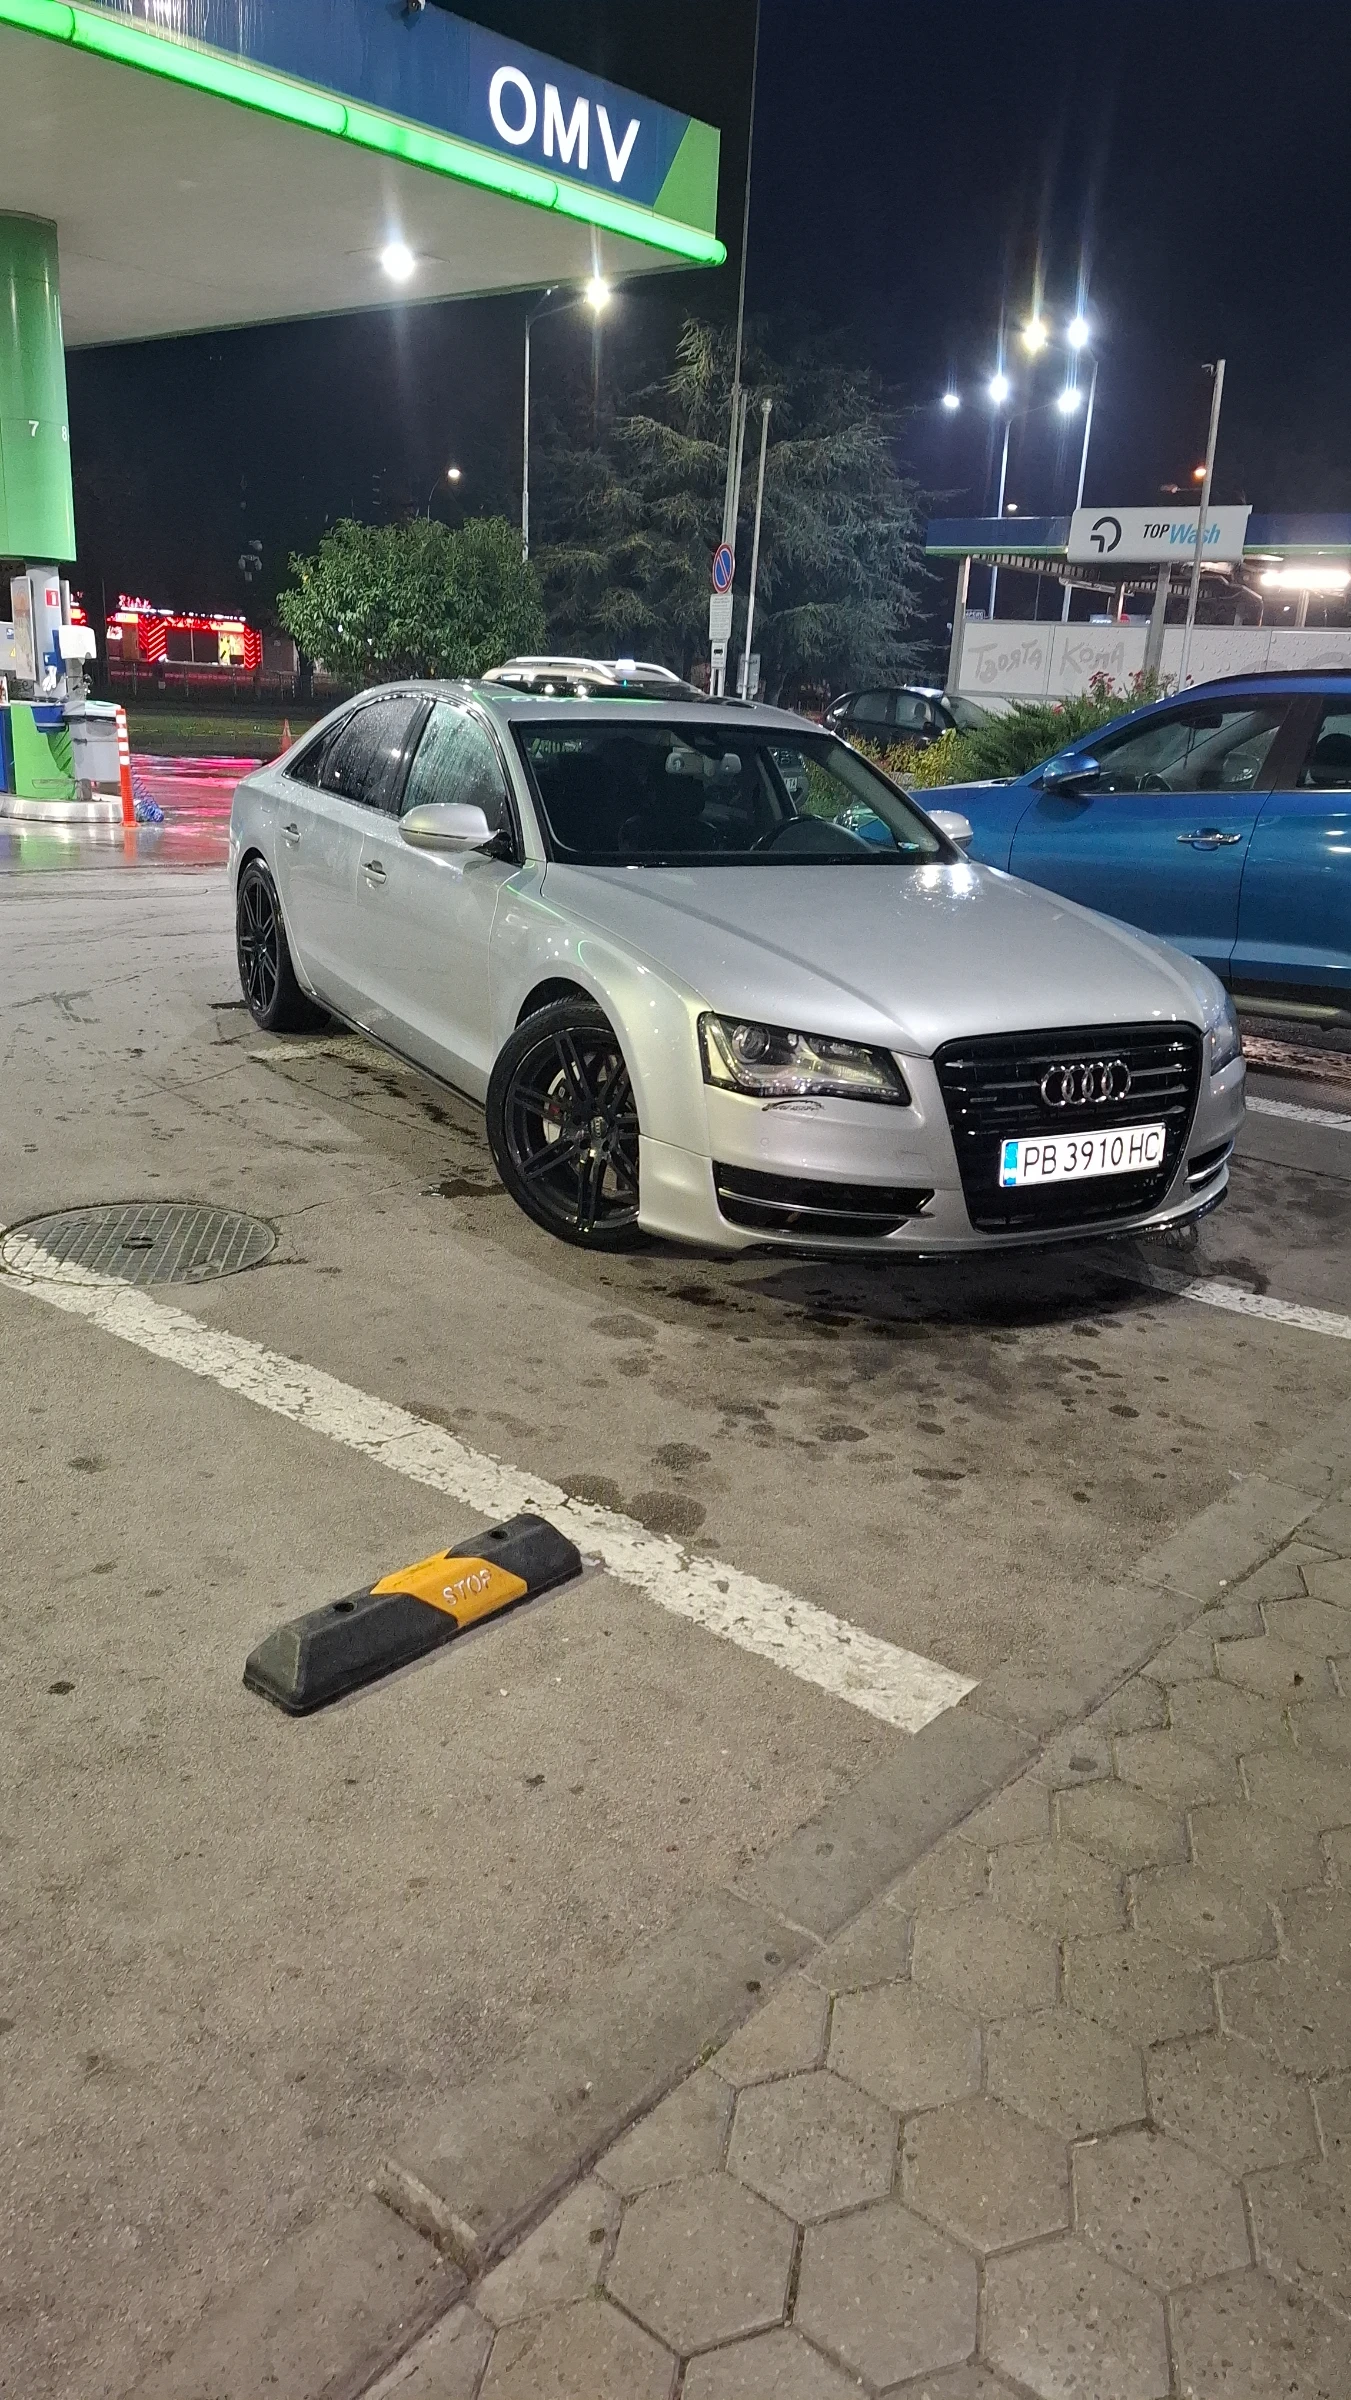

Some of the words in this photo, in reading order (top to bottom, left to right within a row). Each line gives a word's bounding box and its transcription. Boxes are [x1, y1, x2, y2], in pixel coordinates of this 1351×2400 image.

[489, 65, 641, 183] OMV
[28, 419, 40, 437] 7
[61, 425, 68, 442] 8
[1063, 1136, 1124, 1172] 3910
[443, 1568, 492, 1606] STOP
